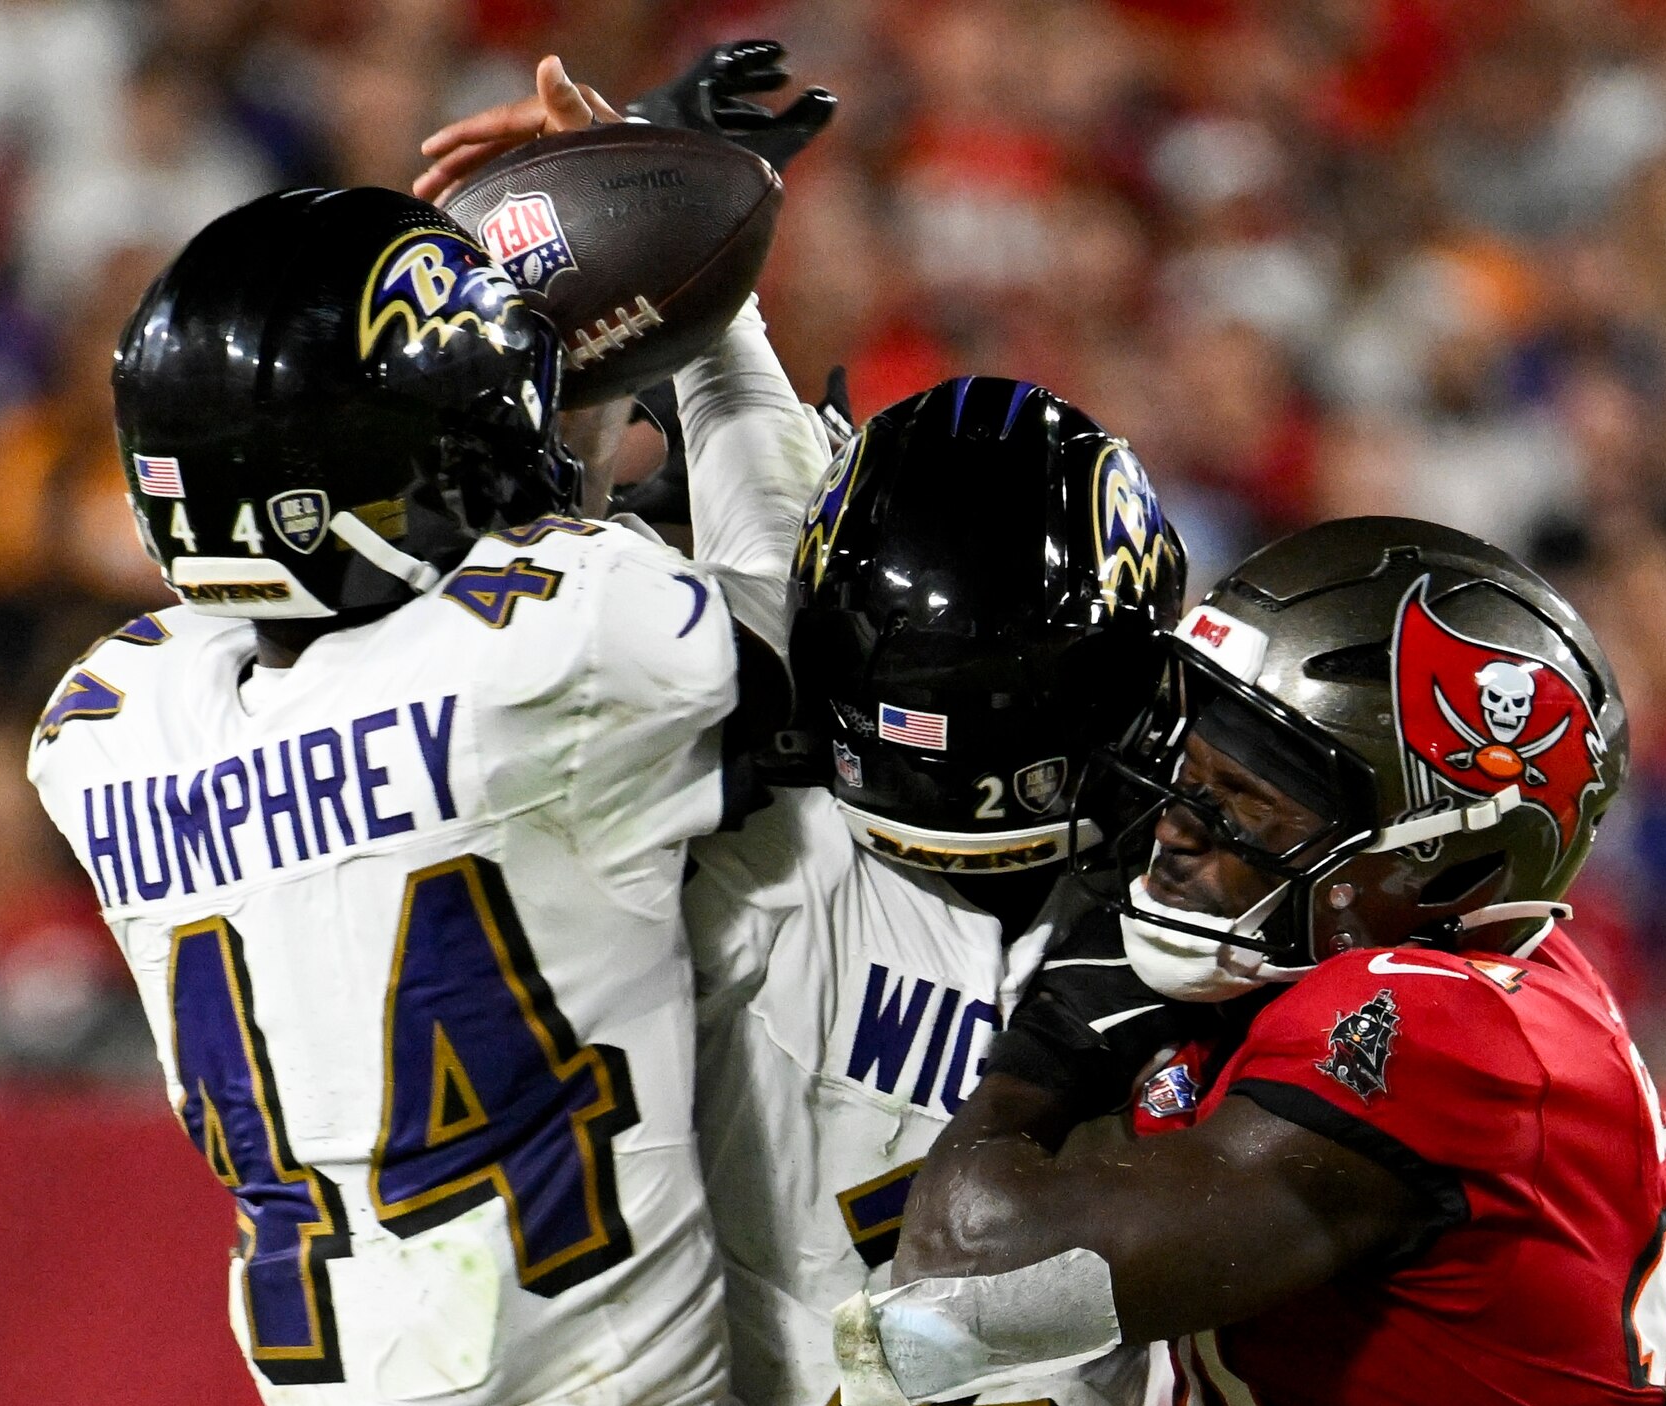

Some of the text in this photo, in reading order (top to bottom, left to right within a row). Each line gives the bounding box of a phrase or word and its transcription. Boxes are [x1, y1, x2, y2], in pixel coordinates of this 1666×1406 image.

[487, 202, 552, 259] NFL
[383, 243, 457, 316] B
[83, 694, 458, 908] HUMPHREY
[973, 775, 1006, 819] 2
[168, 852, 640, 1385] 44
